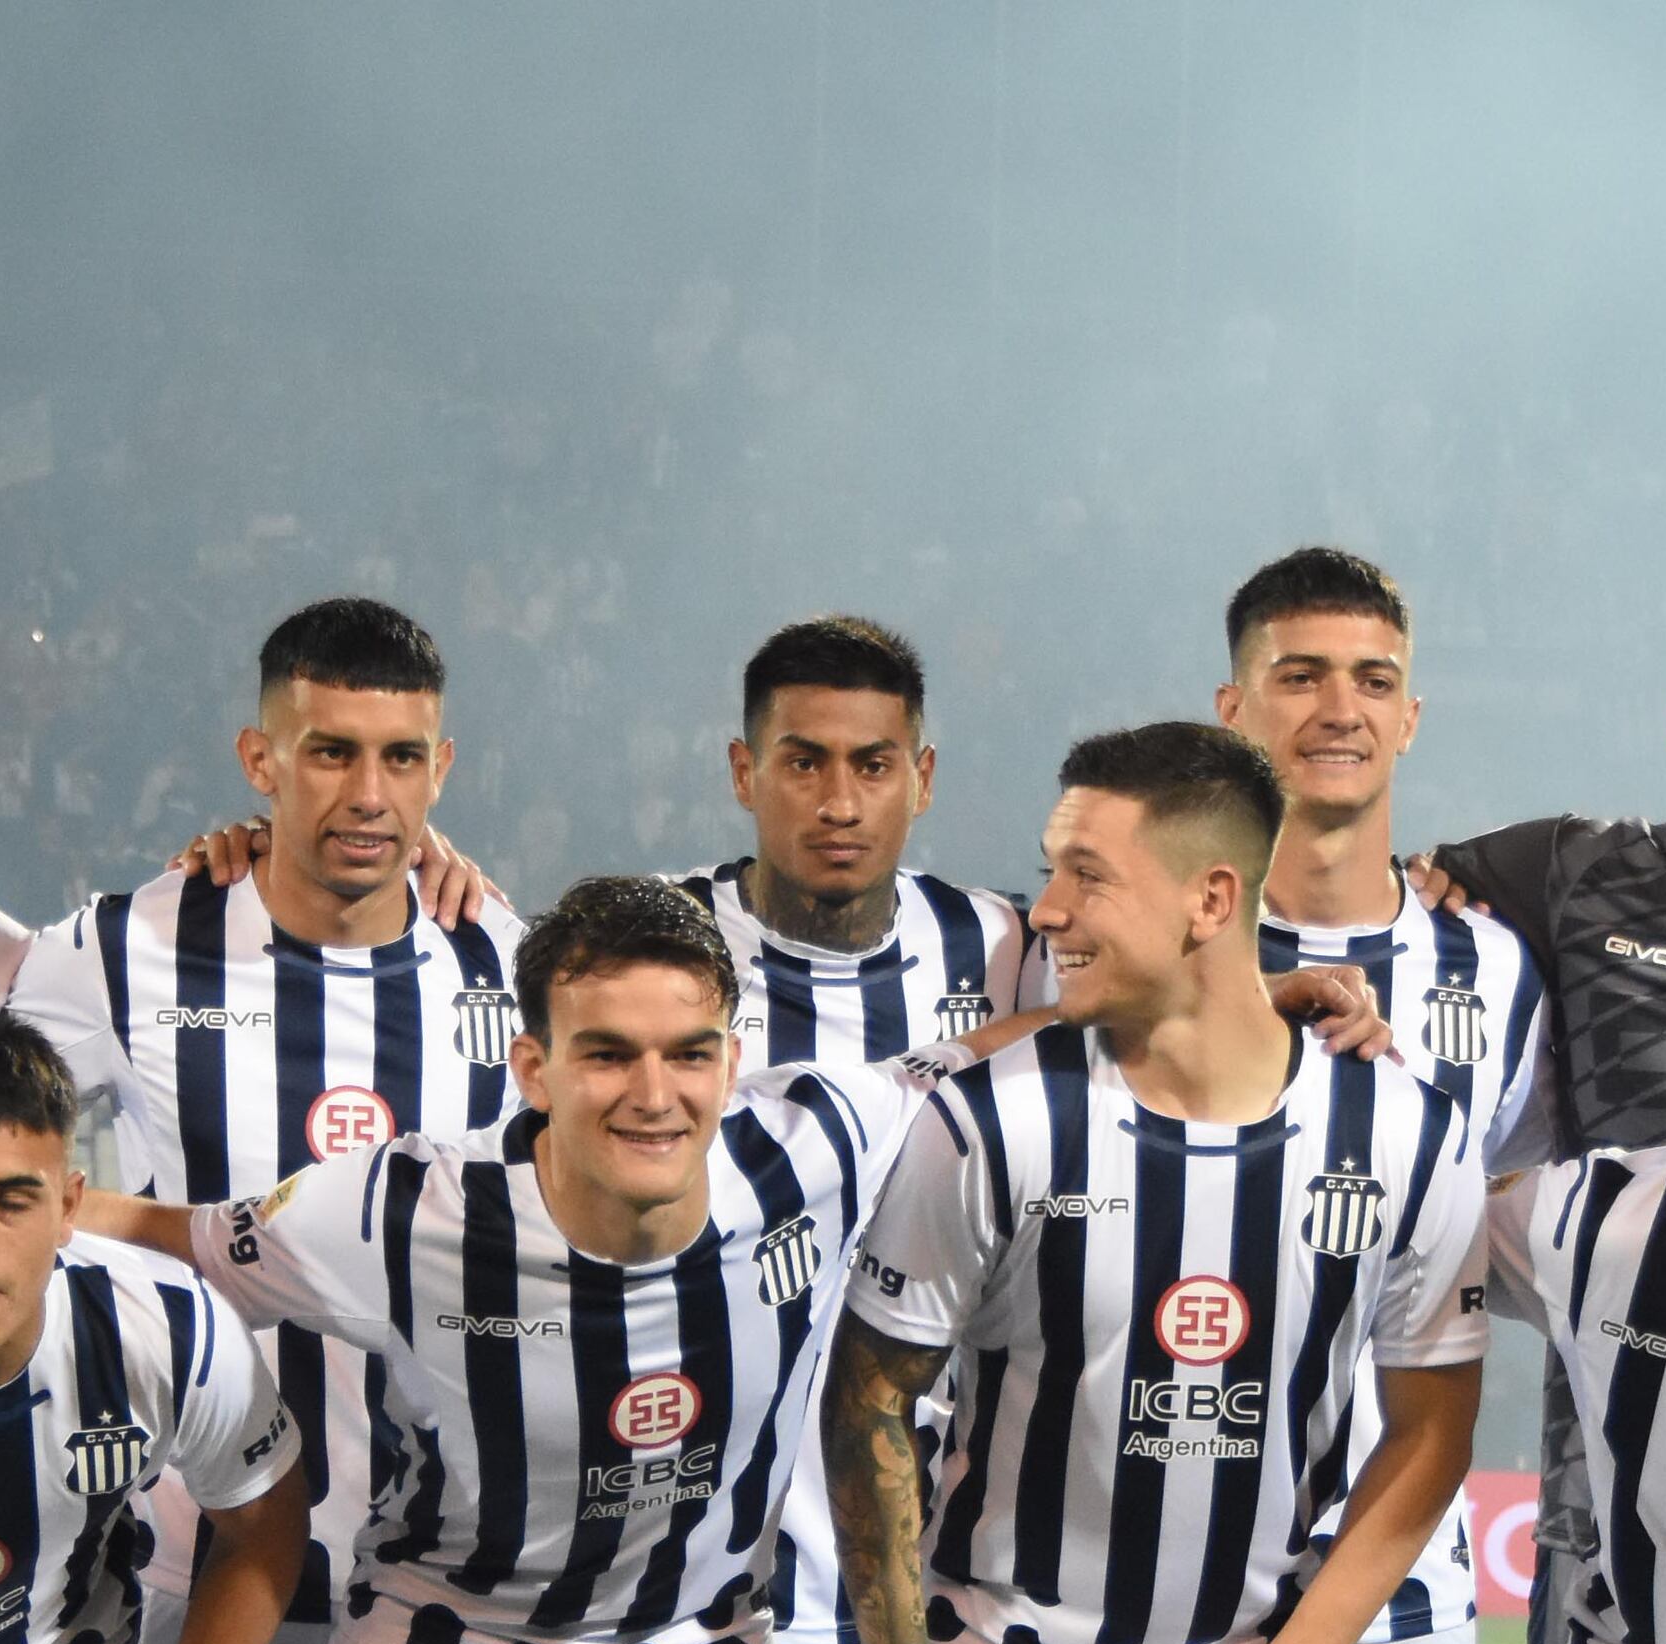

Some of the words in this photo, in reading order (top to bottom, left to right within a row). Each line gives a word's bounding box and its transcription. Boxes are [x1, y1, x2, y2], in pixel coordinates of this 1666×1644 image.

[467, 992, 501, 1004] C.A.T
[948, 999, 979, 1010] C.A.T
[1437, 990, 1472, 1005] C.A.T
[156, 1008, 272, 1029] GIVOVA
[1326, 1178, 1367, 1192] C.A.T
[765, 1224, 801, 1249] C.A.T
[436, 1314, 564, 1337] GIVOVA
[1129, 1379, 1262, 1424] ICBC
[85, 1431, 129, 1445] C.A.T
[1123, 1432, 1258, 1460] Argentina
[587, 1444, 716, 1497] ICBC
[582, 1481, 712, 1521] Argentina
